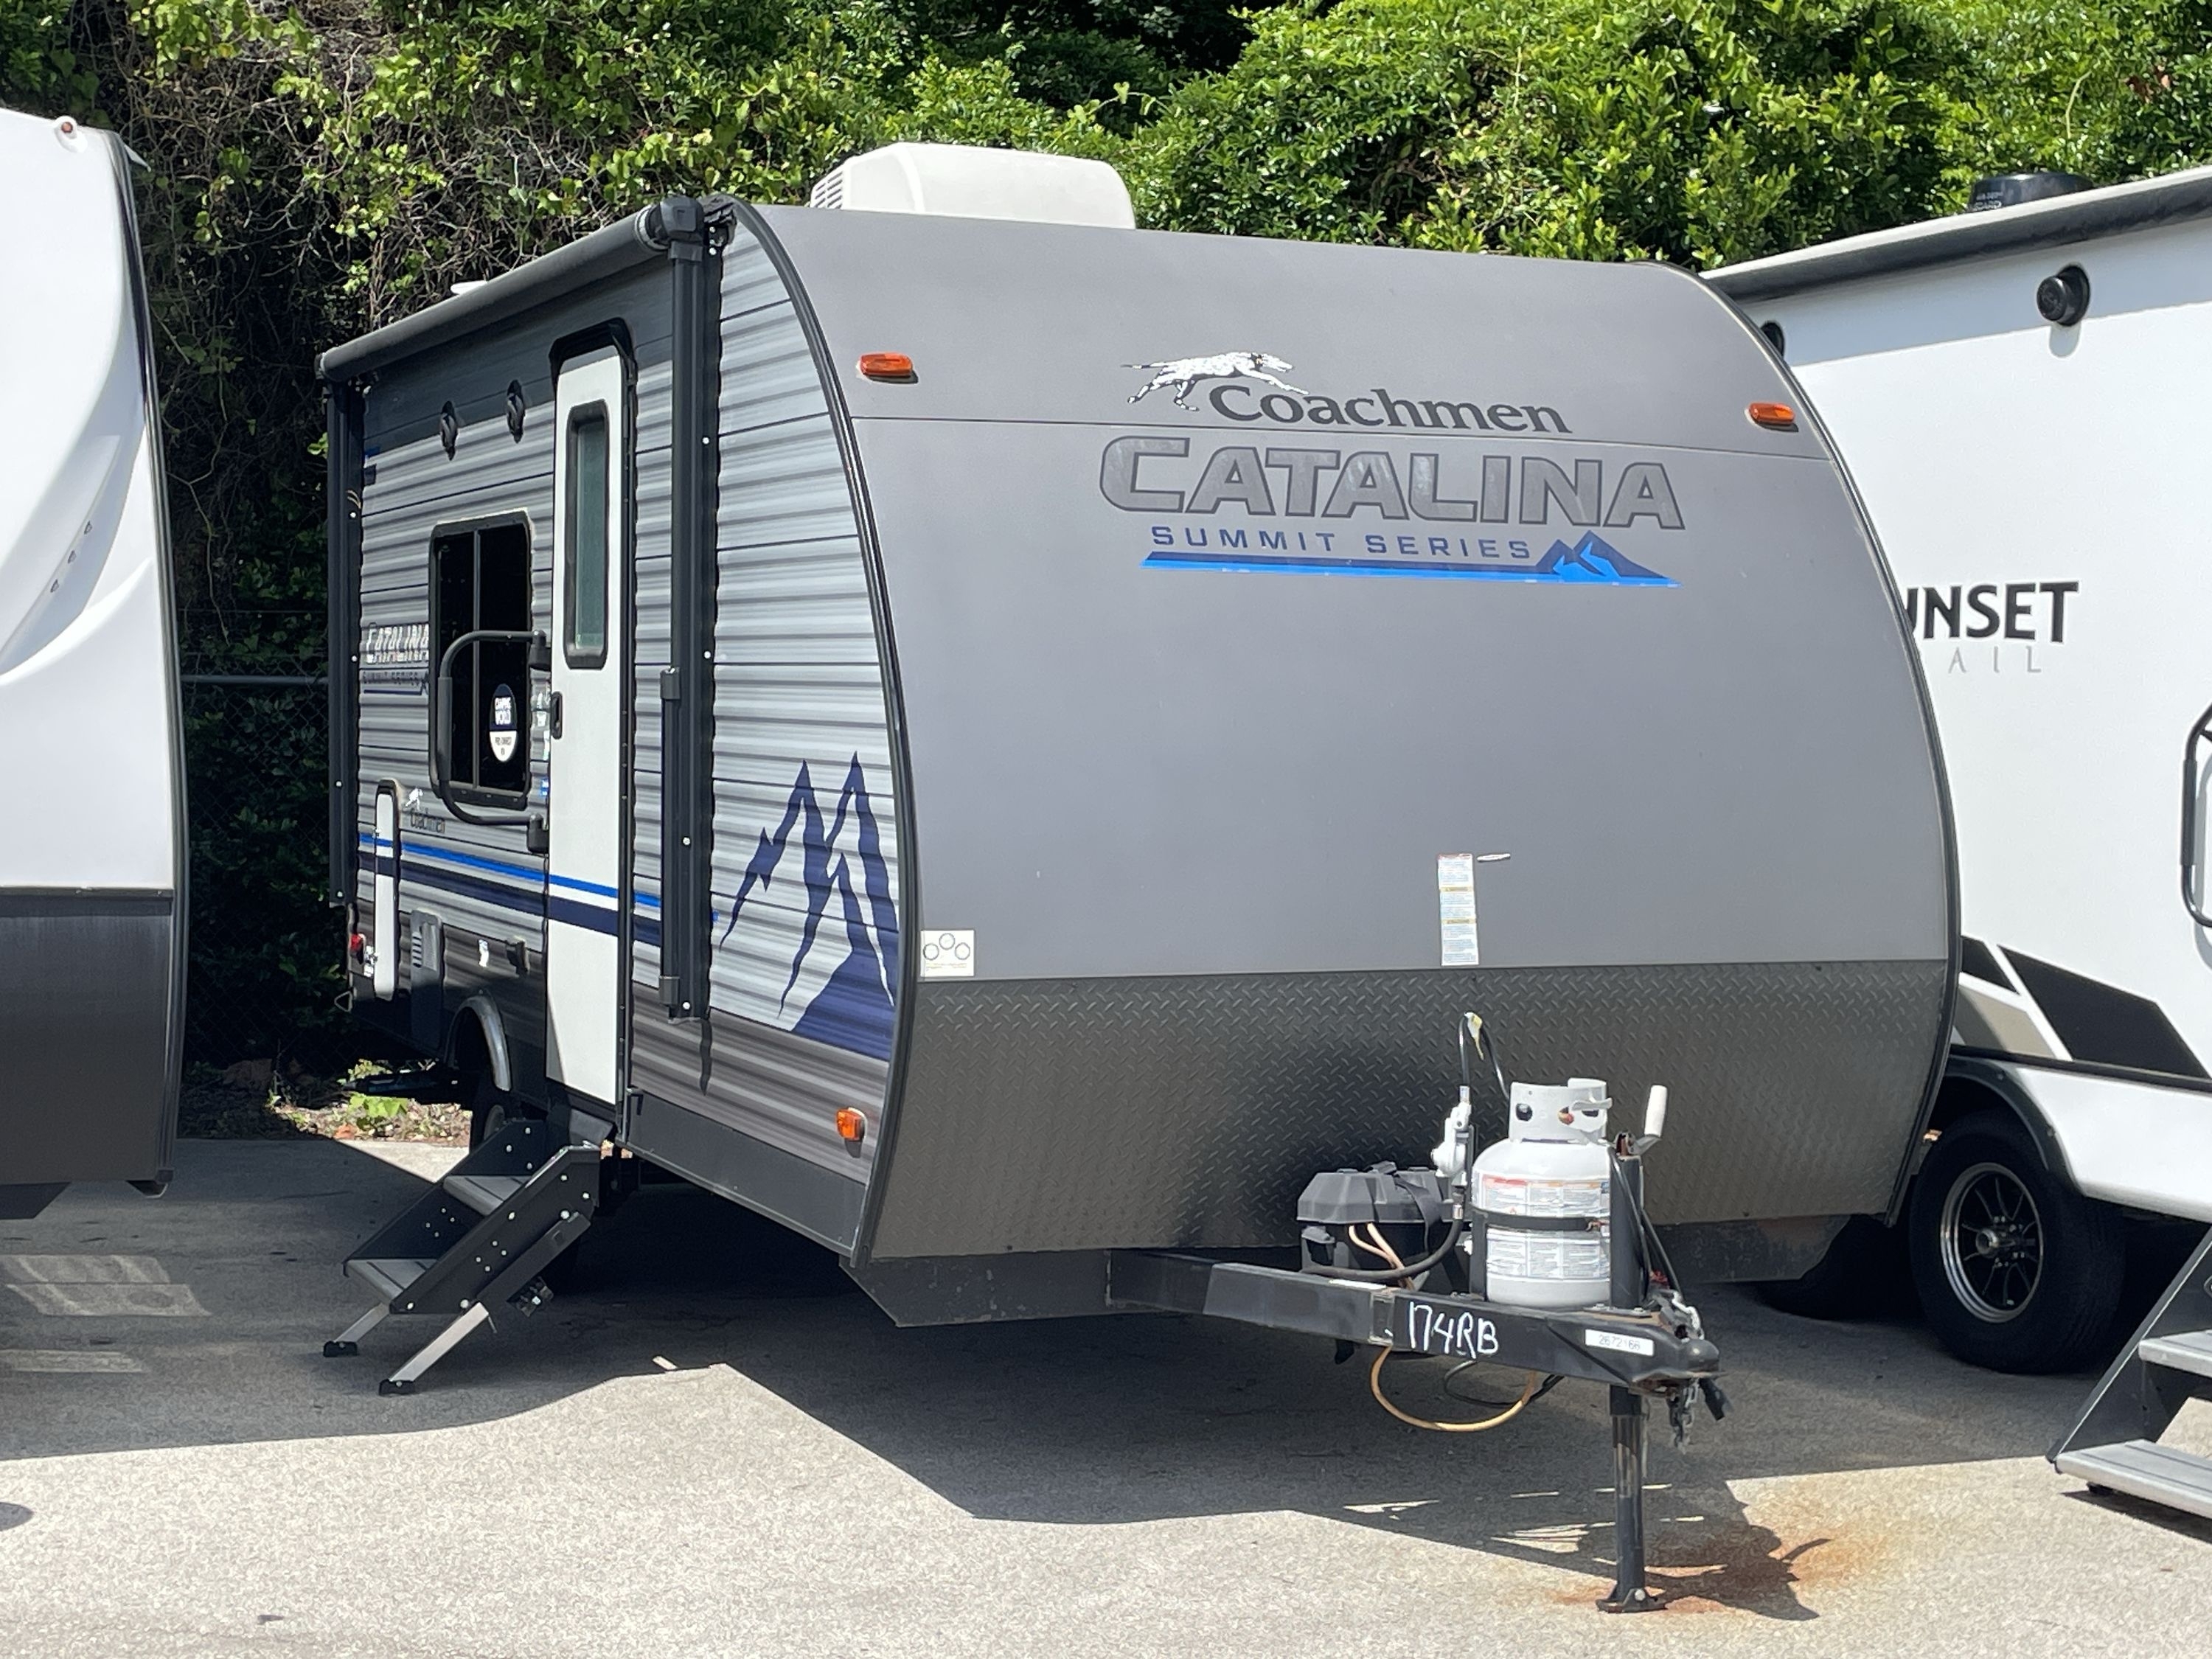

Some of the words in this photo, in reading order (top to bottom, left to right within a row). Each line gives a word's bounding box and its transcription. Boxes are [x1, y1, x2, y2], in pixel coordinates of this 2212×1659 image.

[1209, 384, 1573, 434] Coachmen
[1099, 435, 1686, 530] CATALINA
[1151, 526, 1335, 552] SUMMIT
[1366, 534, 1531, 560] SERIES
[1409, 1301, 1499, 1360] 174RB
